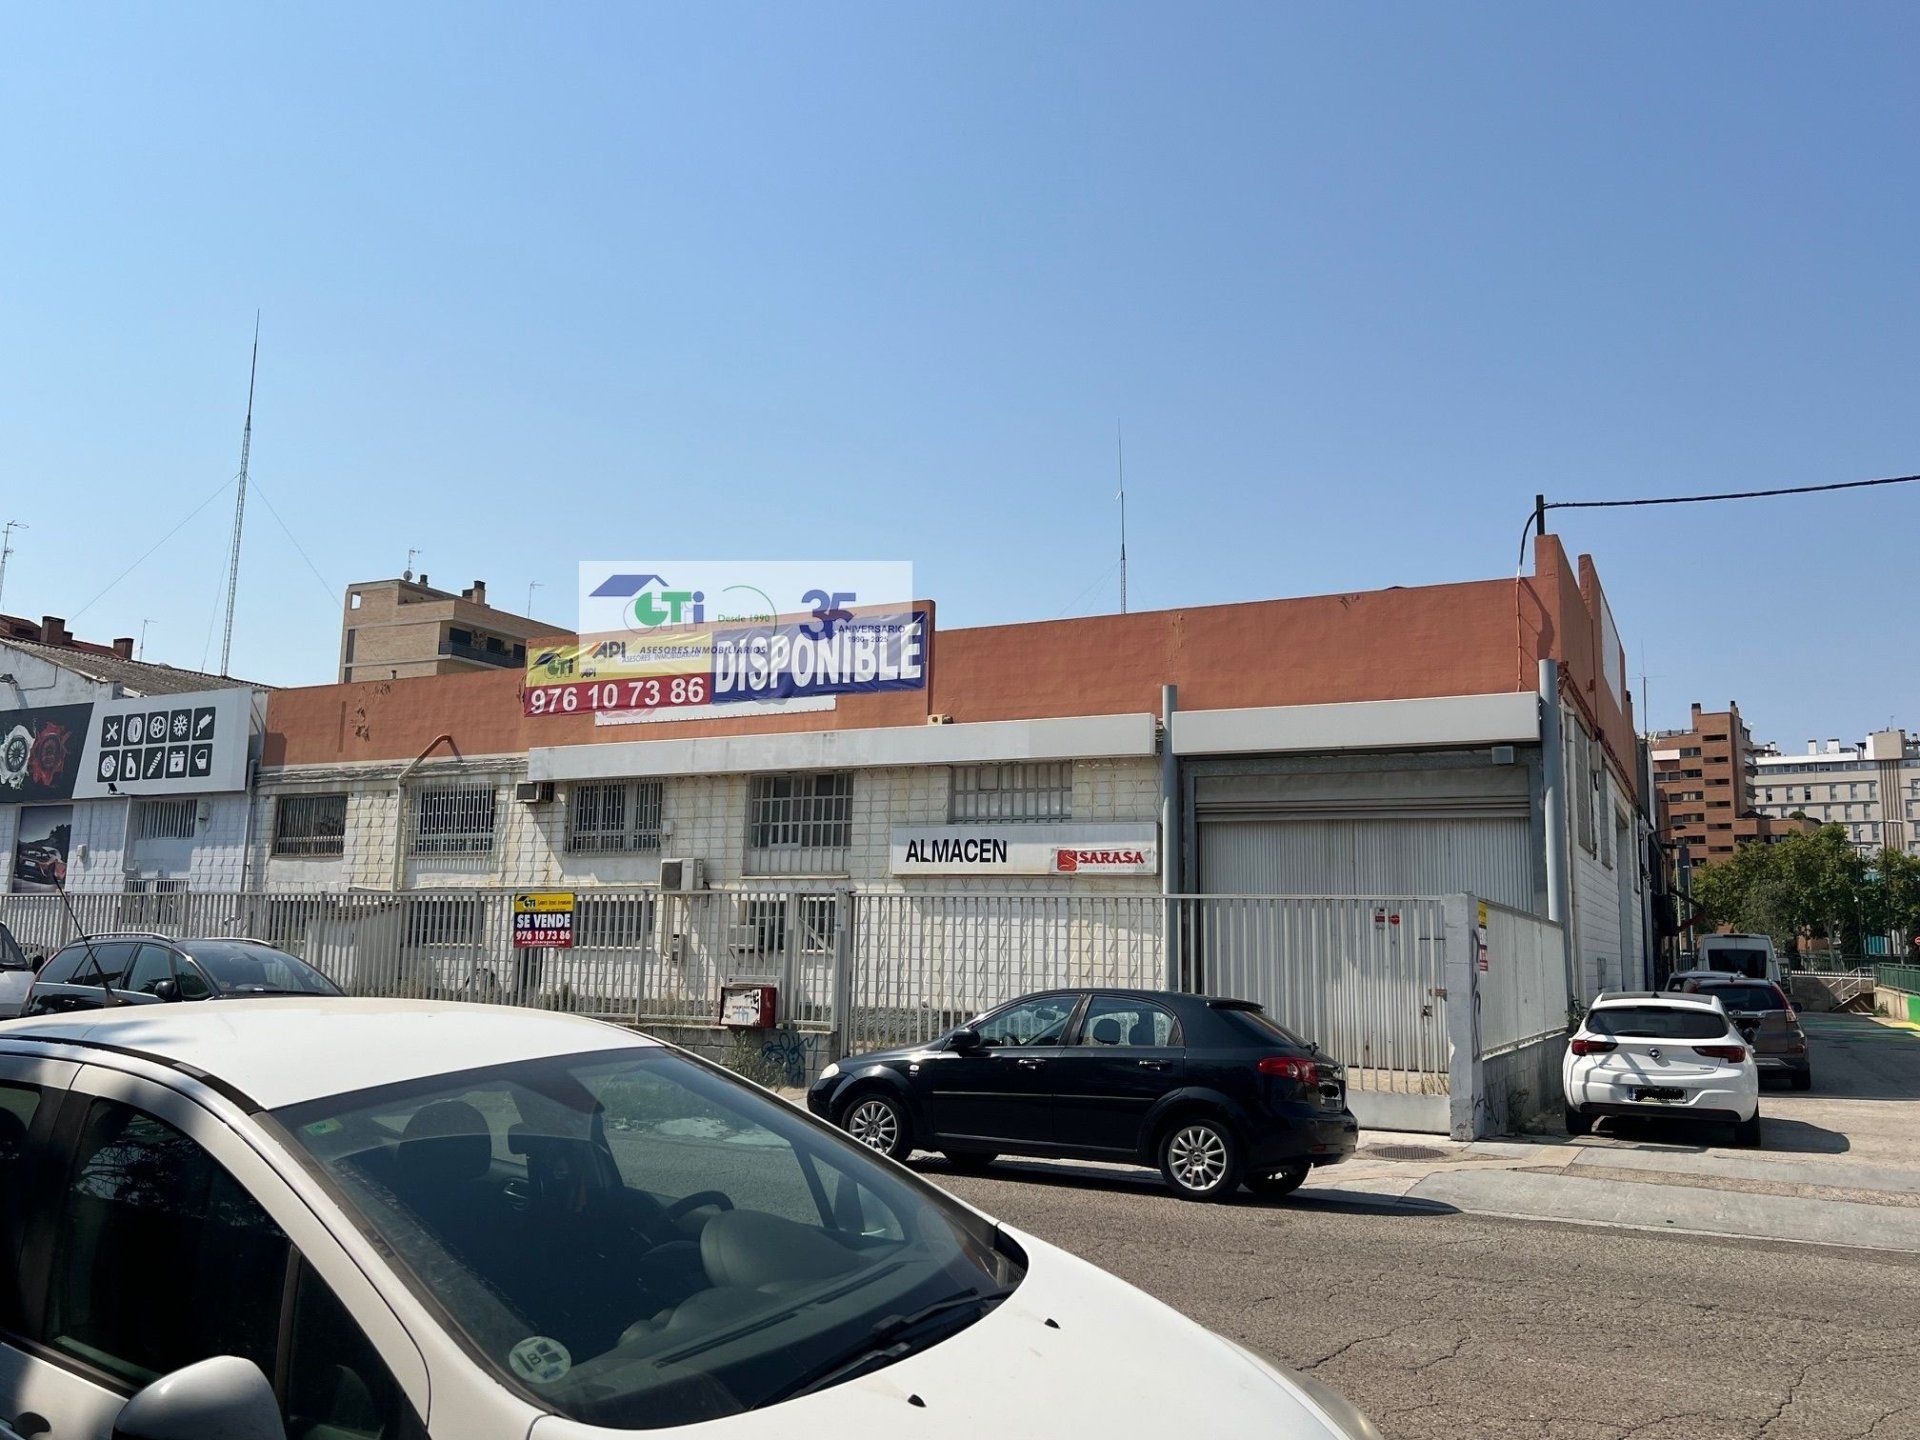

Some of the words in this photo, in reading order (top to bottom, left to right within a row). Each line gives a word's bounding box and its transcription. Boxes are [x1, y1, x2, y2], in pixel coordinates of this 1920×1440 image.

[621, 652, 651, 663] ASESORES
[714, 622, 922, 693] DISPONIBLE
[531, 687, 578, 714] 976
[588, 683, 618, 709] 10
[628, 680, 661, 706] 73
[670, 676, 705, 703] 86
[905, 838, 1008, 863] ALMACEN
[1078, 851, 1145, 864] SARASA
[516, 913, 531, 928] SE
[533, 913, 571, 928] VENDE
[515, 930, 533, 940] 976
[535, 930, 545, 940] 10
[547, 930, 558, 940] 73
[559, 930, 571, 940] 86
